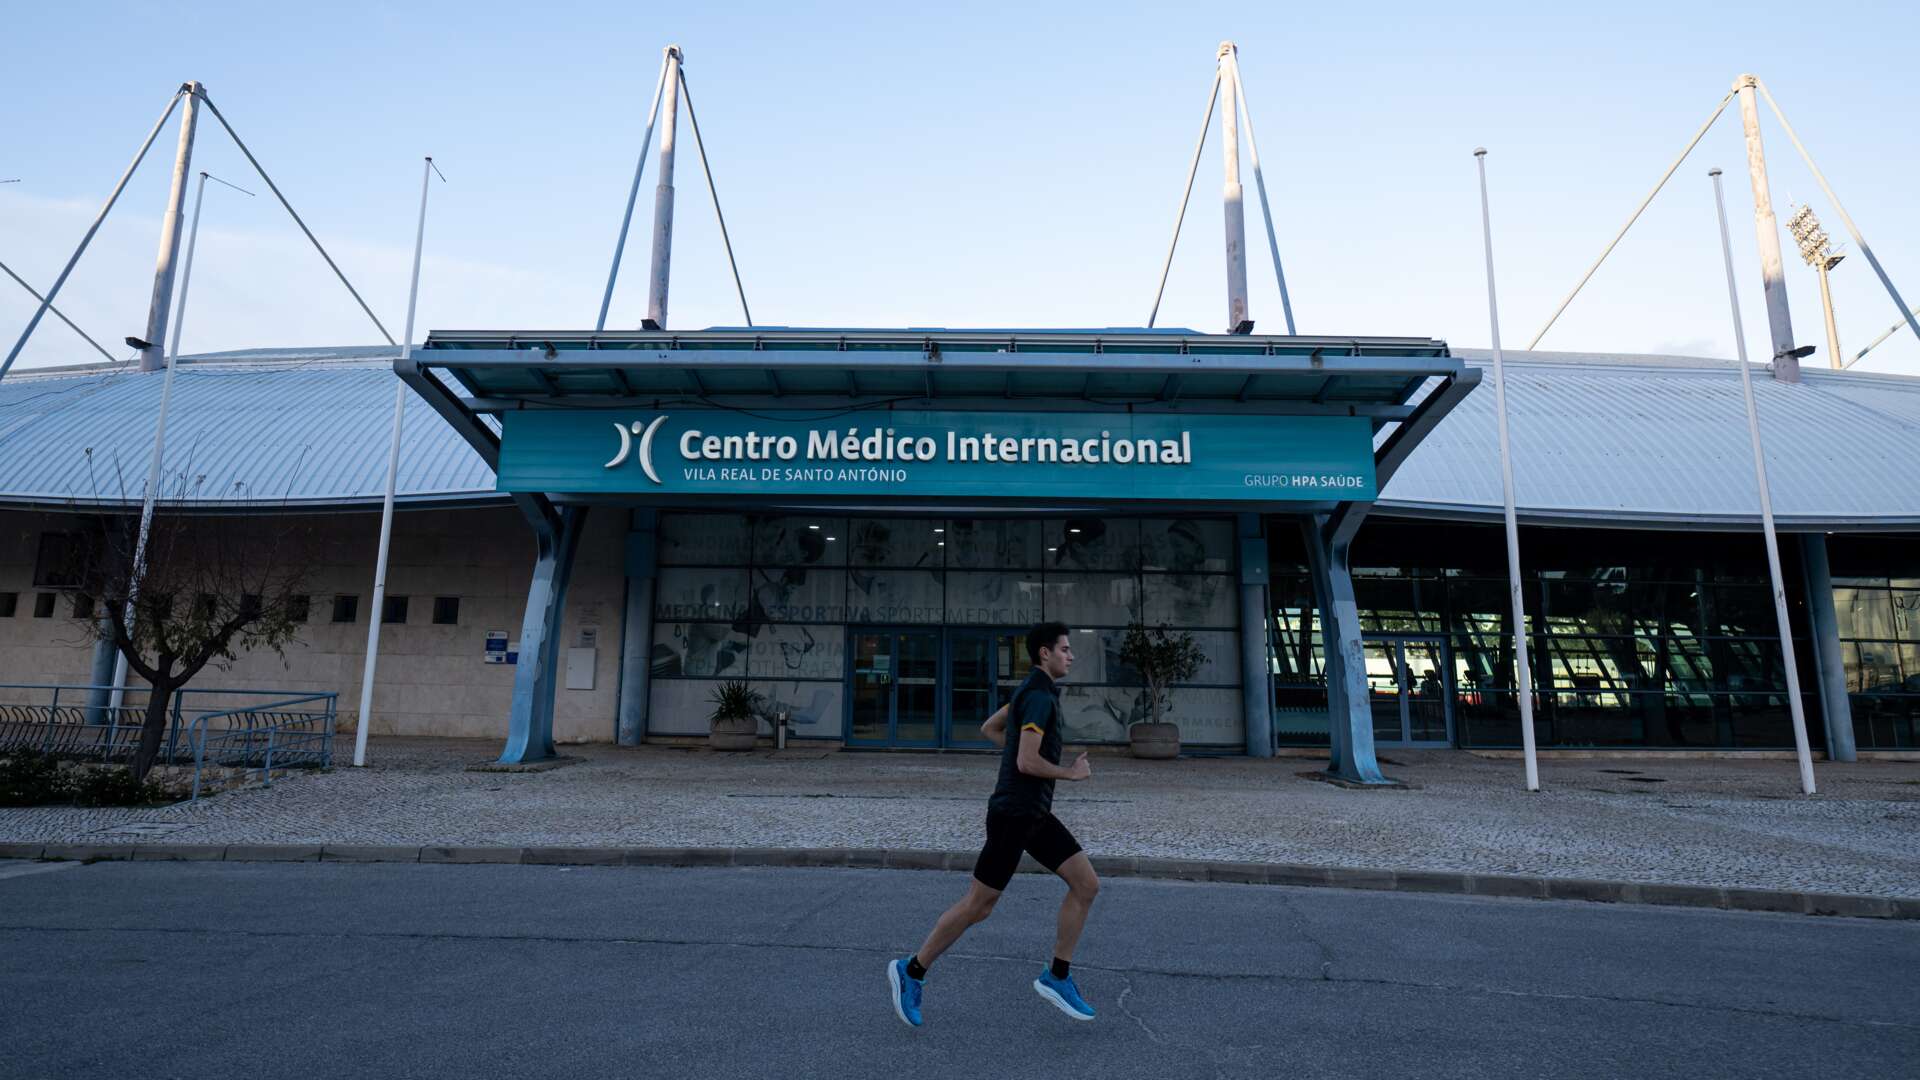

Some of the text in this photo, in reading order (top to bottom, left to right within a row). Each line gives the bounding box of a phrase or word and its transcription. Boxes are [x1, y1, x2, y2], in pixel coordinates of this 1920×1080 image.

[680, 428, 1192, 463] Centro Médico Internacional
[684, 466, 907, 482] VILA REAL DE SANTO ANTÓNIO
[1244, 474, 1364, 488] GRUPO HPA SAÚDE
[765, 605, 871, 624] ESPORTIVA
